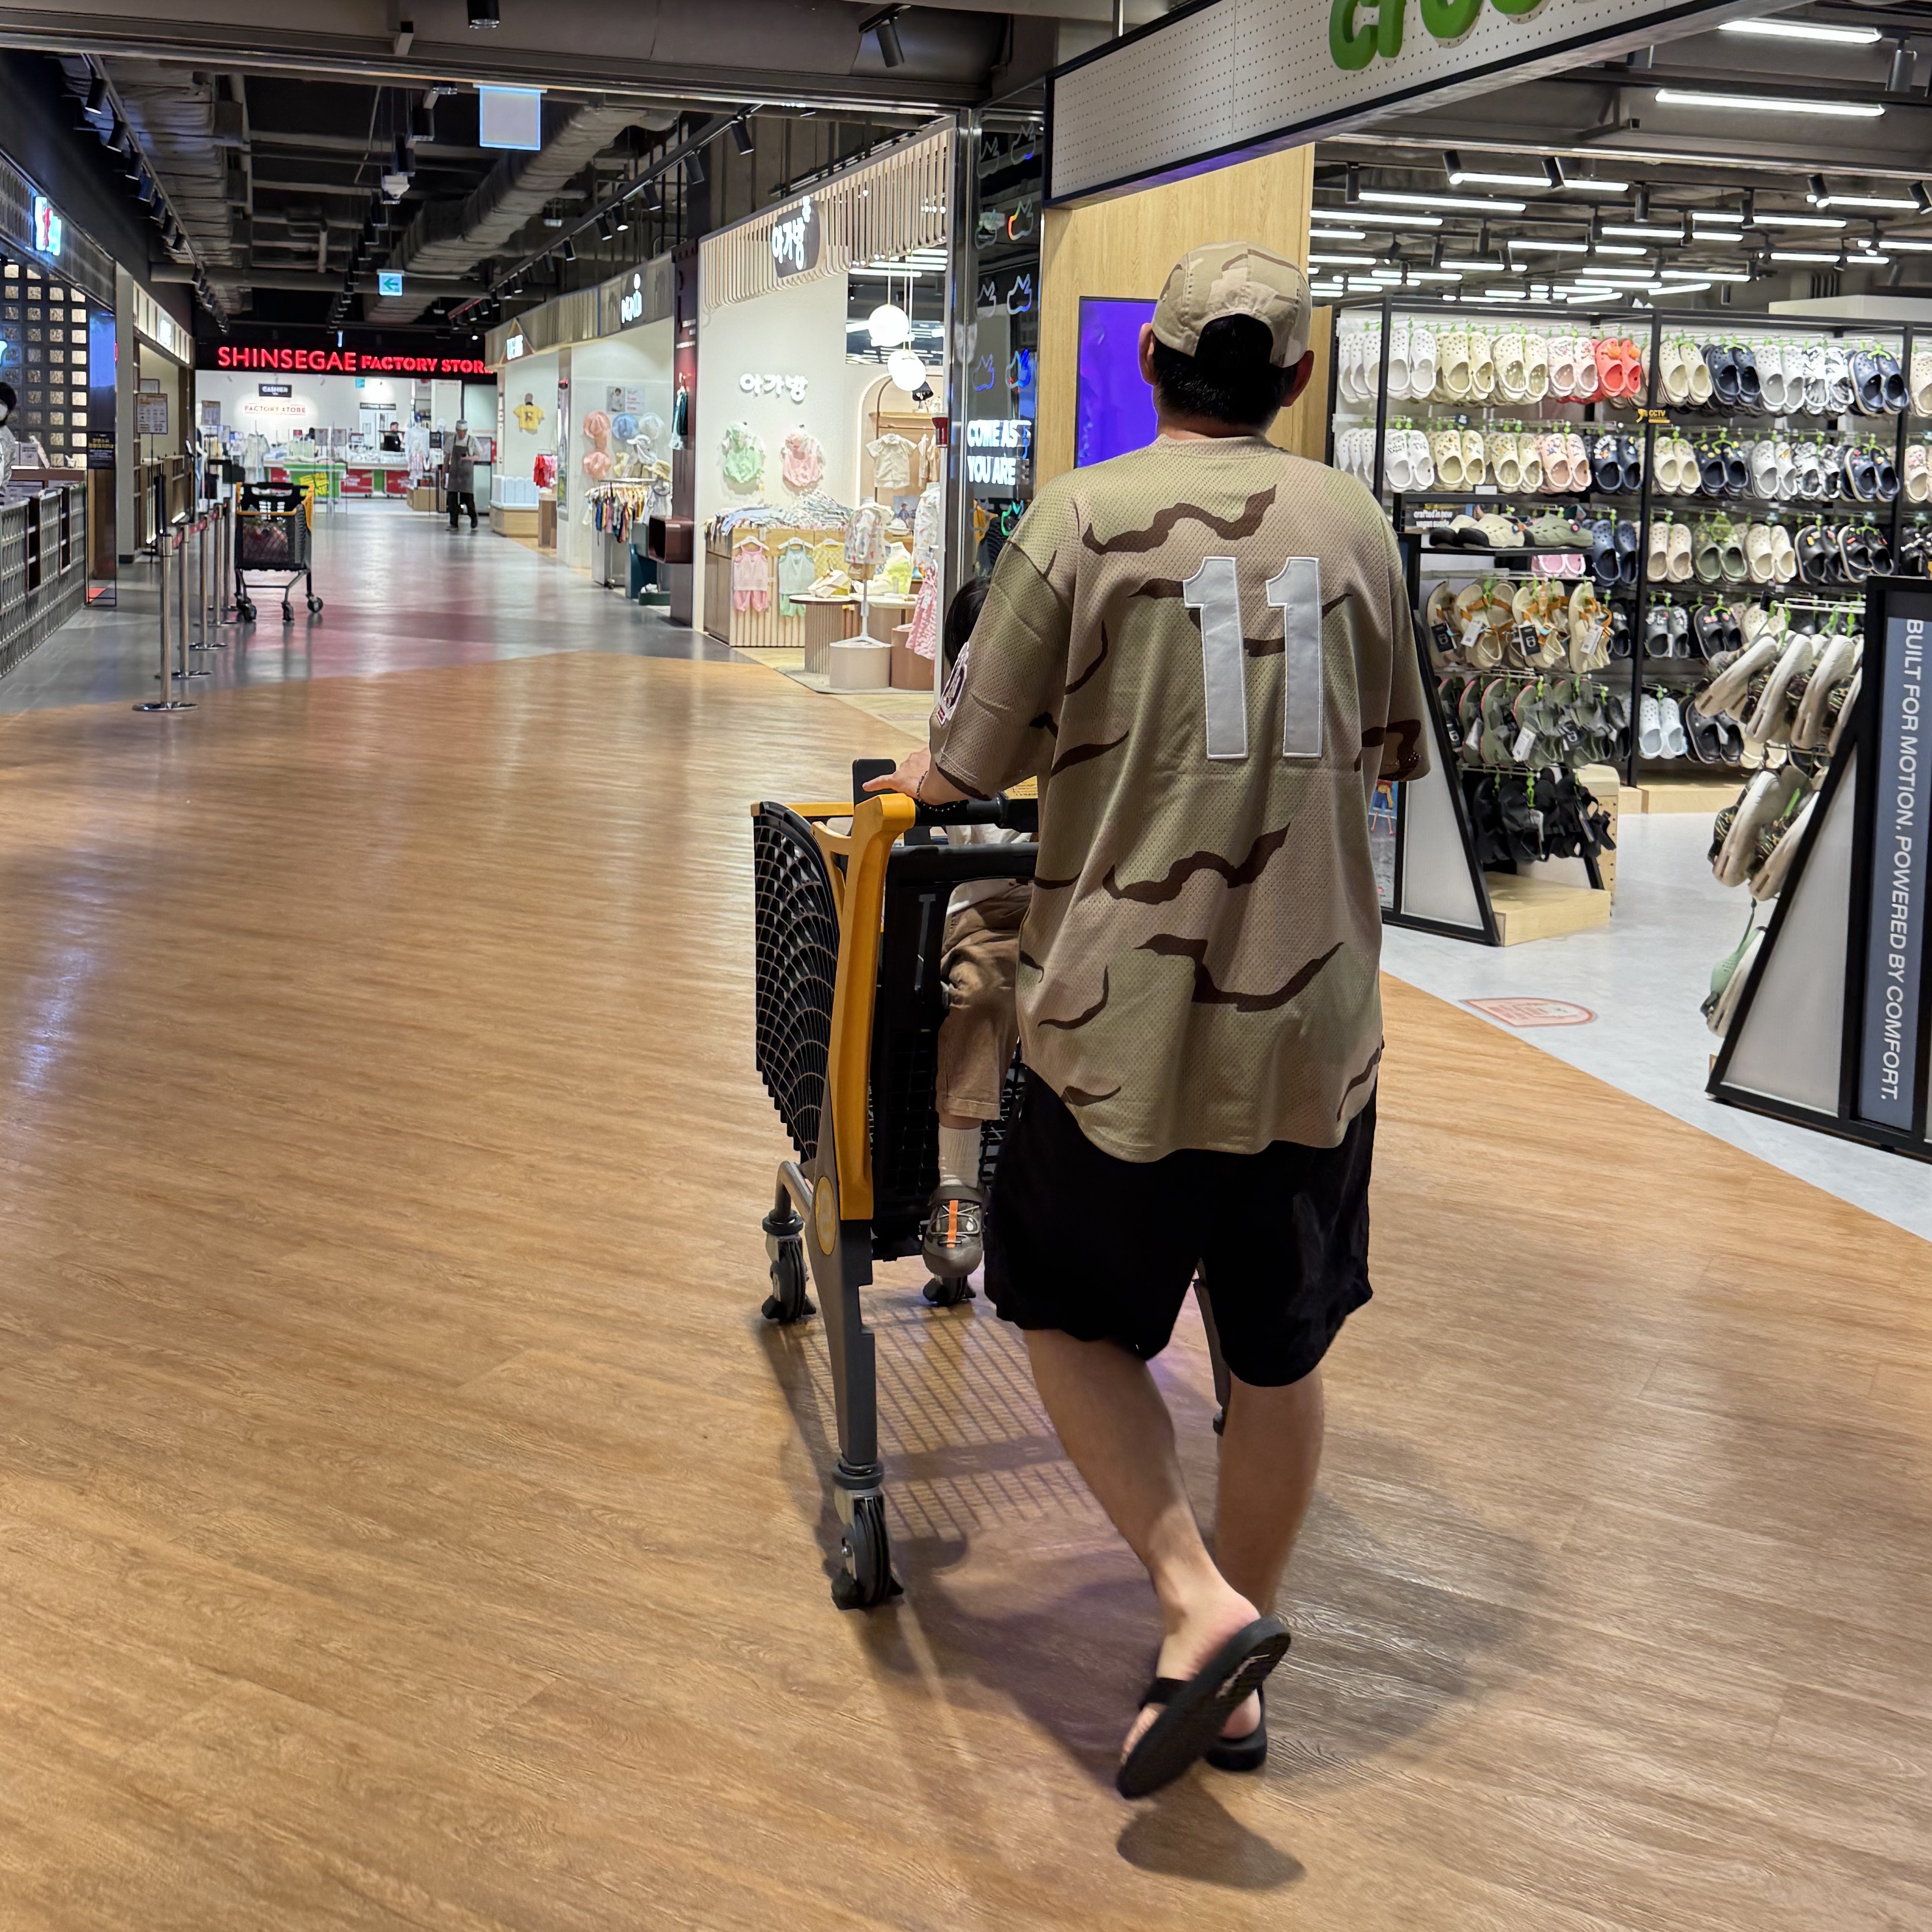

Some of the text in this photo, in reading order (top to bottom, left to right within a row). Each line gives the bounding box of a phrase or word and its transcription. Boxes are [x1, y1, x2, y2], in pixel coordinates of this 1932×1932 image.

[217, 346, 494, 374] SHINSEGAE FACTORY STOR
[740, 373, 809, 402] 아가방
[967, 420, 1018, 448] COME AS
[967, 456, 1016, 486] YOU ARE
[1182, 556, 1323, 759] 11
[1881, 618, 1924, 1100] BUILT FOR MOTION. POWERED BY COMFORT.
